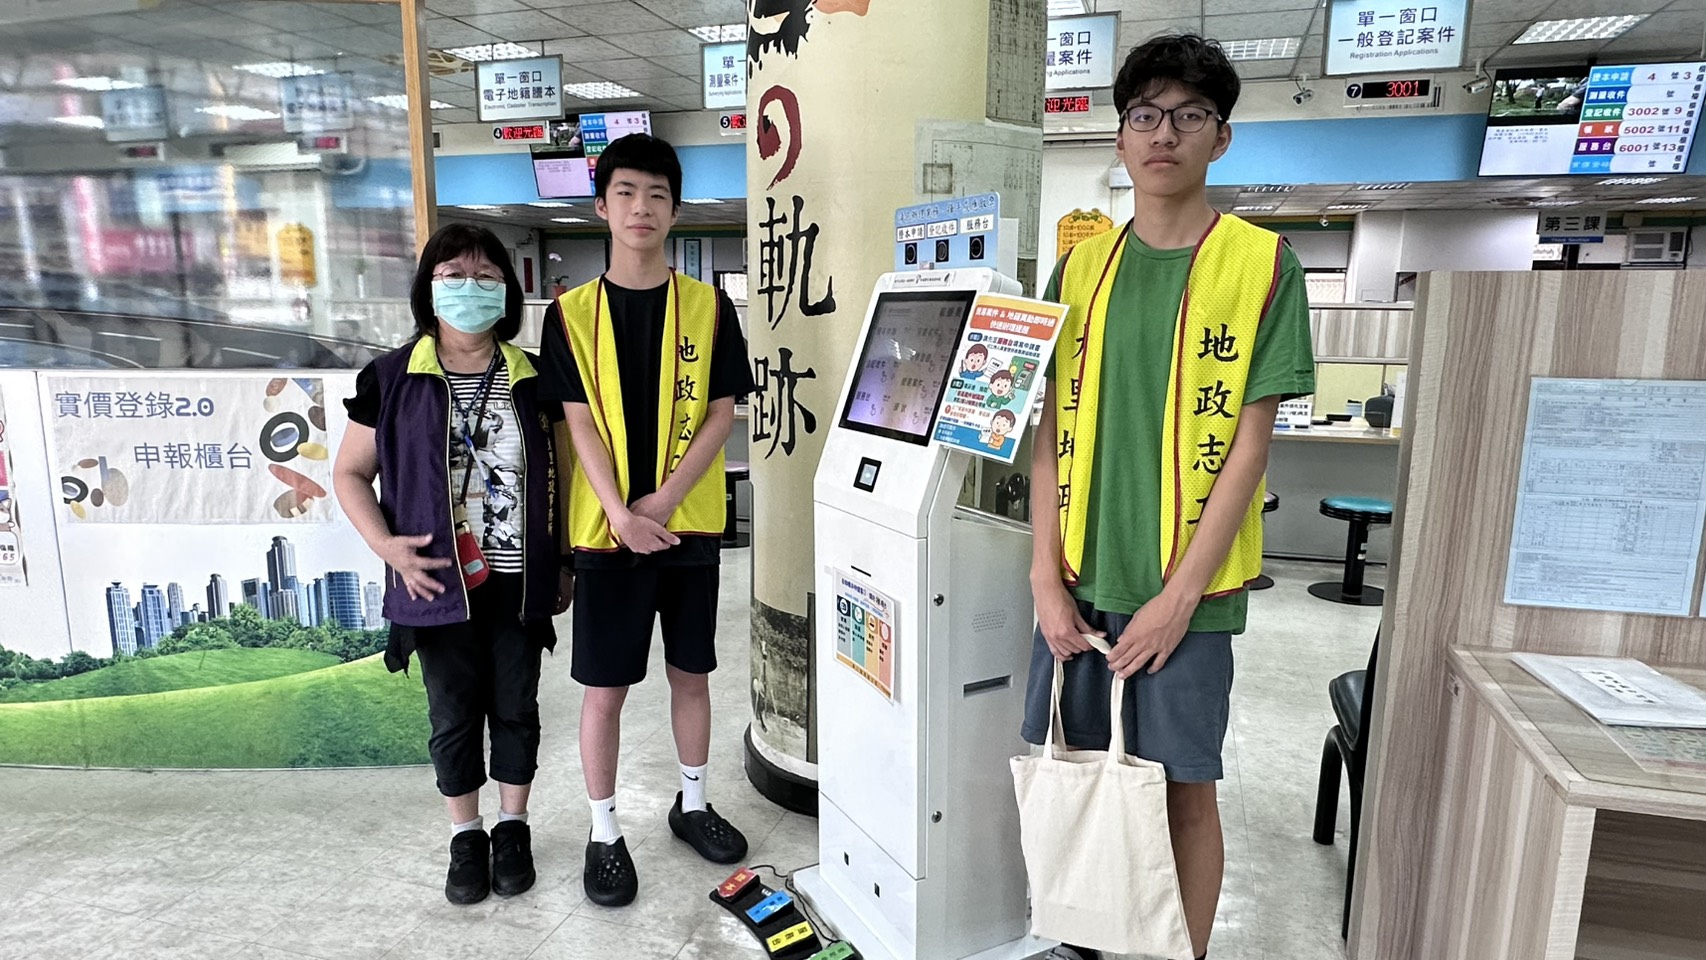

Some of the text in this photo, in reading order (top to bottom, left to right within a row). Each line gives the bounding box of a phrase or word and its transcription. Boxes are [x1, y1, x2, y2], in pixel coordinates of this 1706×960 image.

[1357, 7, 1437, 27] 單一窗口
[1338, 26, 1455, 48] 一般登記案件
[1350, 48, 1439, 60] Registration Applications
[495, 71, 542, 84] 單一窗口
[1054, 69, 1090, 77] Applications
[1683, 72, 1691, 80] 3
[483, 85, 555, 101] 電子地籍謄本
[1386, 81, 1419, 97] 3001
[1628, 107, 1659, 116] 3002
[1674, 106, 1682, 115] 9
[1624, 126, 1655, 134] 5002
[1668, 125, 1680, 133] 11
[1619, 144, 1649, 152] 6001
[1661, 143, 1676, 152] 13
[966, 217, 988, 230] 服務台
[1545, 216, 1600, 231] 第三課
[56, 391, 214, 418] 實價登錄2.0
[134, 443, 252, 469] 申報櫃台
